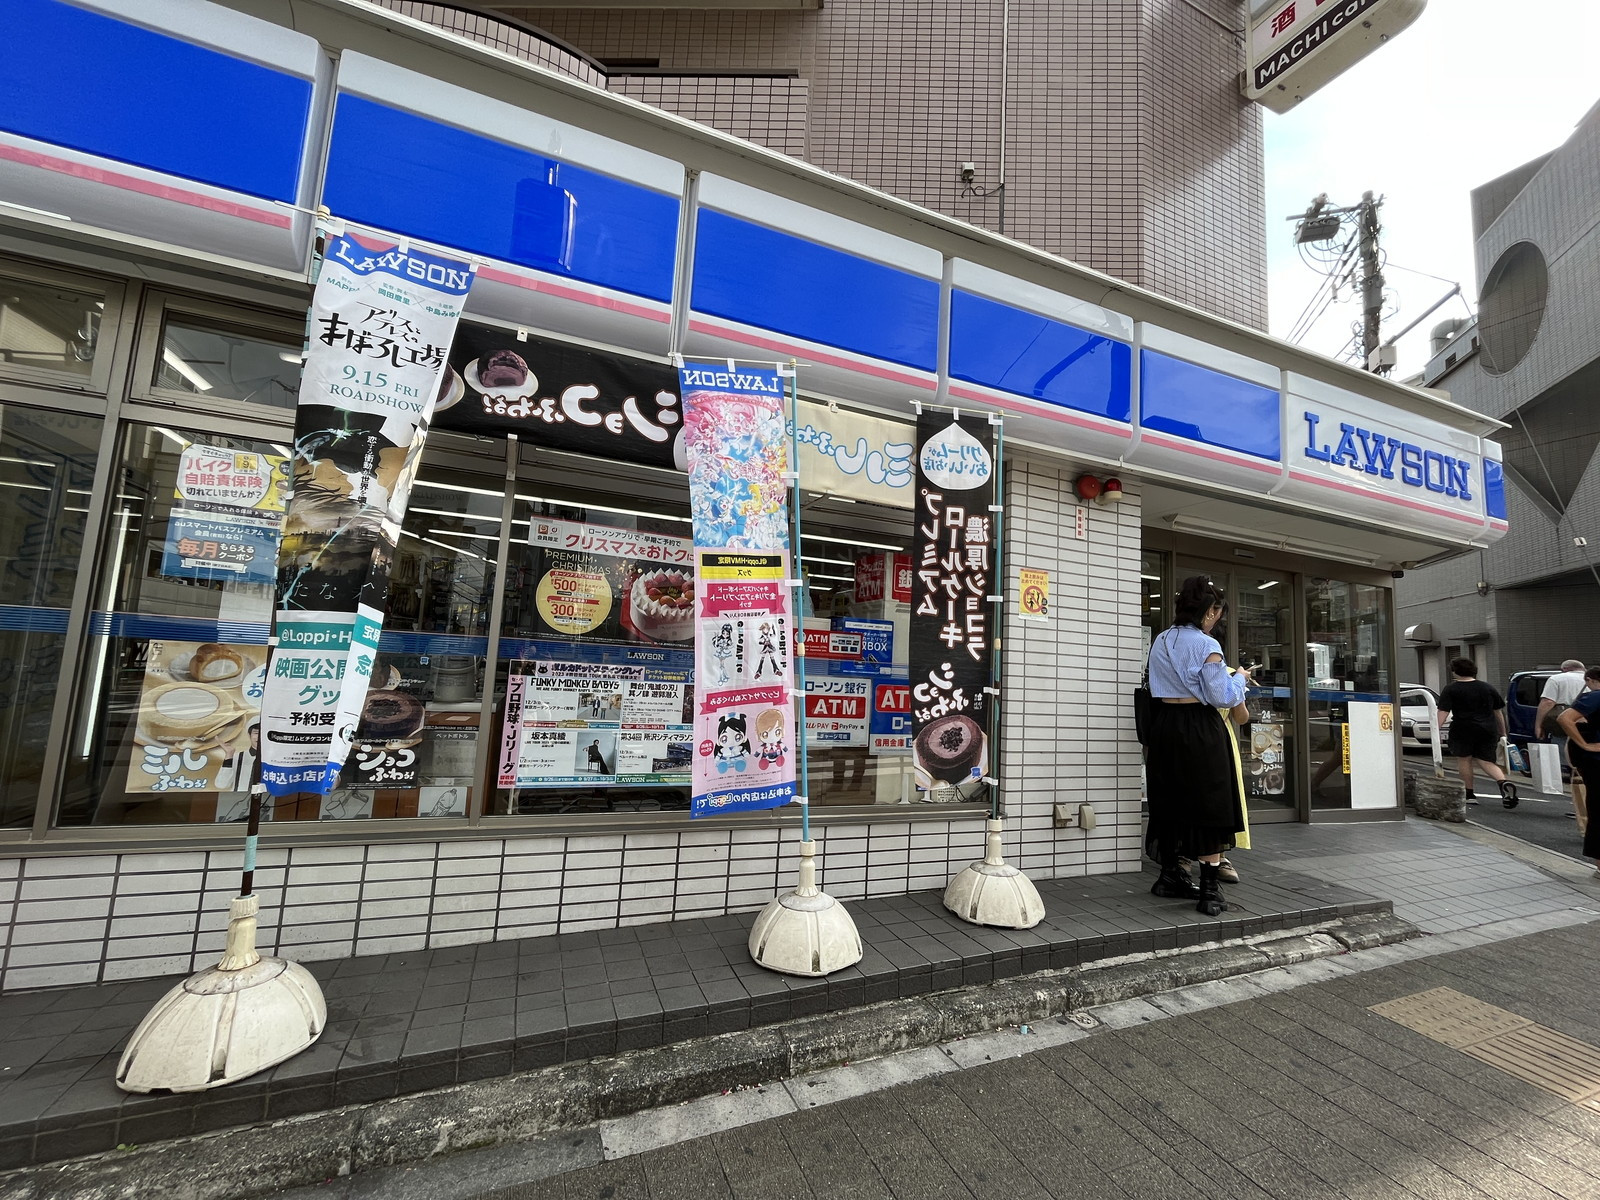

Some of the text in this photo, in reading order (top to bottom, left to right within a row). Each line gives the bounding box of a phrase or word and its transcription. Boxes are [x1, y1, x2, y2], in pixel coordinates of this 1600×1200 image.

[1271, 1, 1296, 38] 酒
[1260, 21, 1328, 83] MACHI
[335, 239, 470, 290] LAWSON
[342, 364, 420, 398] 9.15 FRI
[330, 383, 426, 414] ROADSHOW
[1304, 411, 1472, 501] LAWSON
[186, 457, 232, 472] バイク
[184, 473, 263, 489] 自賠責保険
[186, 487, 263, 499] 切れていませんか?
[536, 534, 559, 543] 会員限定
[177, 538, 219, 559] 毎月
[219, 543, 255, 554] もらえる
[565, 533, 695, 563] クリスマスをおトクに
[218, 551, 254, 562] クーポン
[546, 550, 594, 563] PREMIUM
[551, 561, 611, 575] CHRISTMAS
[553, 578, 577, 592] 500
[858, 579, 881, 598] ATM
[550, 603, 575, 617] 300
[806, 634, 828, 643] ATM
[627, 651, 665, 661] LAWSON
[530, 677, 557, 687] FUNKY
[558, 678, 591, 688] MONKEY
[630, 682, 679, 691] 舞台「鬼滅の刃」
[804, 681, 867, 695] ローソン銀行
[813, 698, 857, 715] ATM
[881, 690, 912, 709] AT
[289, 711, 336, 726] 予約受
[1261, 710, 1271, 719] 24
[502, 682, 524, 774] プロ野球・Jリーグ
[839, 723, 859, 731] PayPay
[530, 731, 567, 741] 坂本真綾
[620, 732, 643, 741] 第34回
[874, 738, 905, 747] 信用金庫
[141, 745, 208, 774] ミル
[355, 744, 416, 771] ショコ
